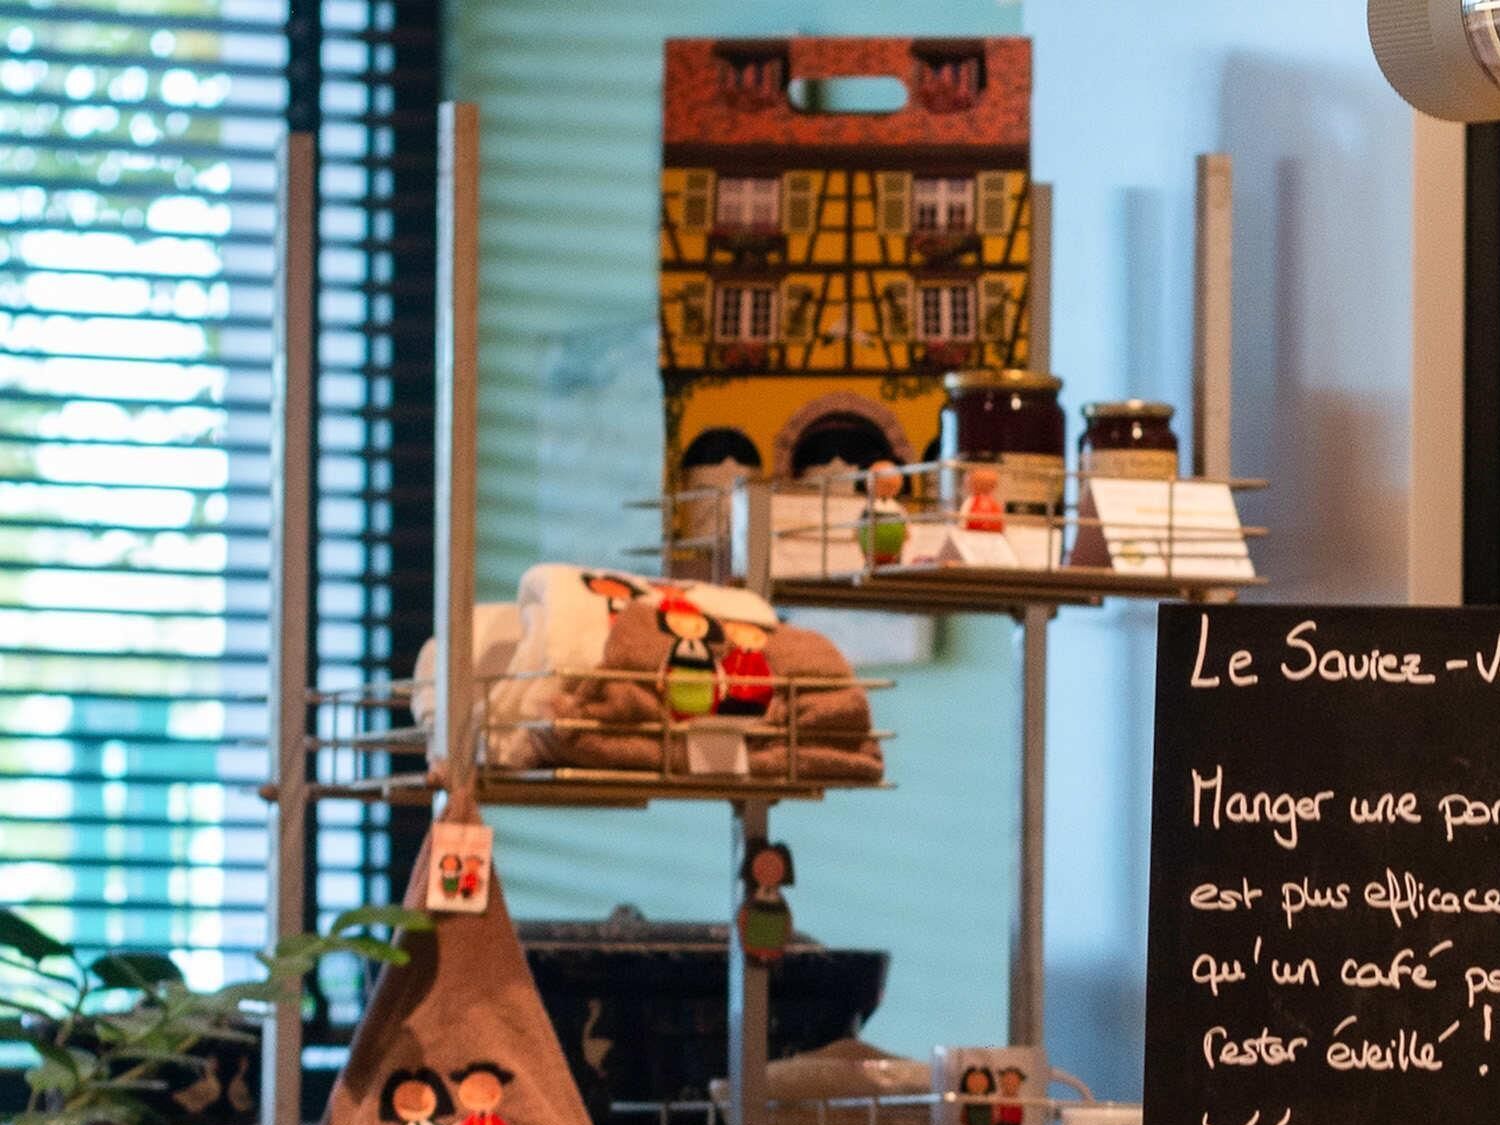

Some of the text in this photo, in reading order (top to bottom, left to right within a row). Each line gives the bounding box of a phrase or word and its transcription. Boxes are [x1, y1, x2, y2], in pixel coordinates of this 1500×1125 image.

[1190, 613, 1259, 688] Le
[1191, 764, 1335, 850] Manger
[1349, 792, 1422, 824] une
[1189, 877, 1263, 911] est
[1281, 876, 1351, 930] plus
[1191, 936, 1320, 997] qu'un
[1340, 939, 1454, 990] café
[1326, 1015, 1460, 1072] éveillé
